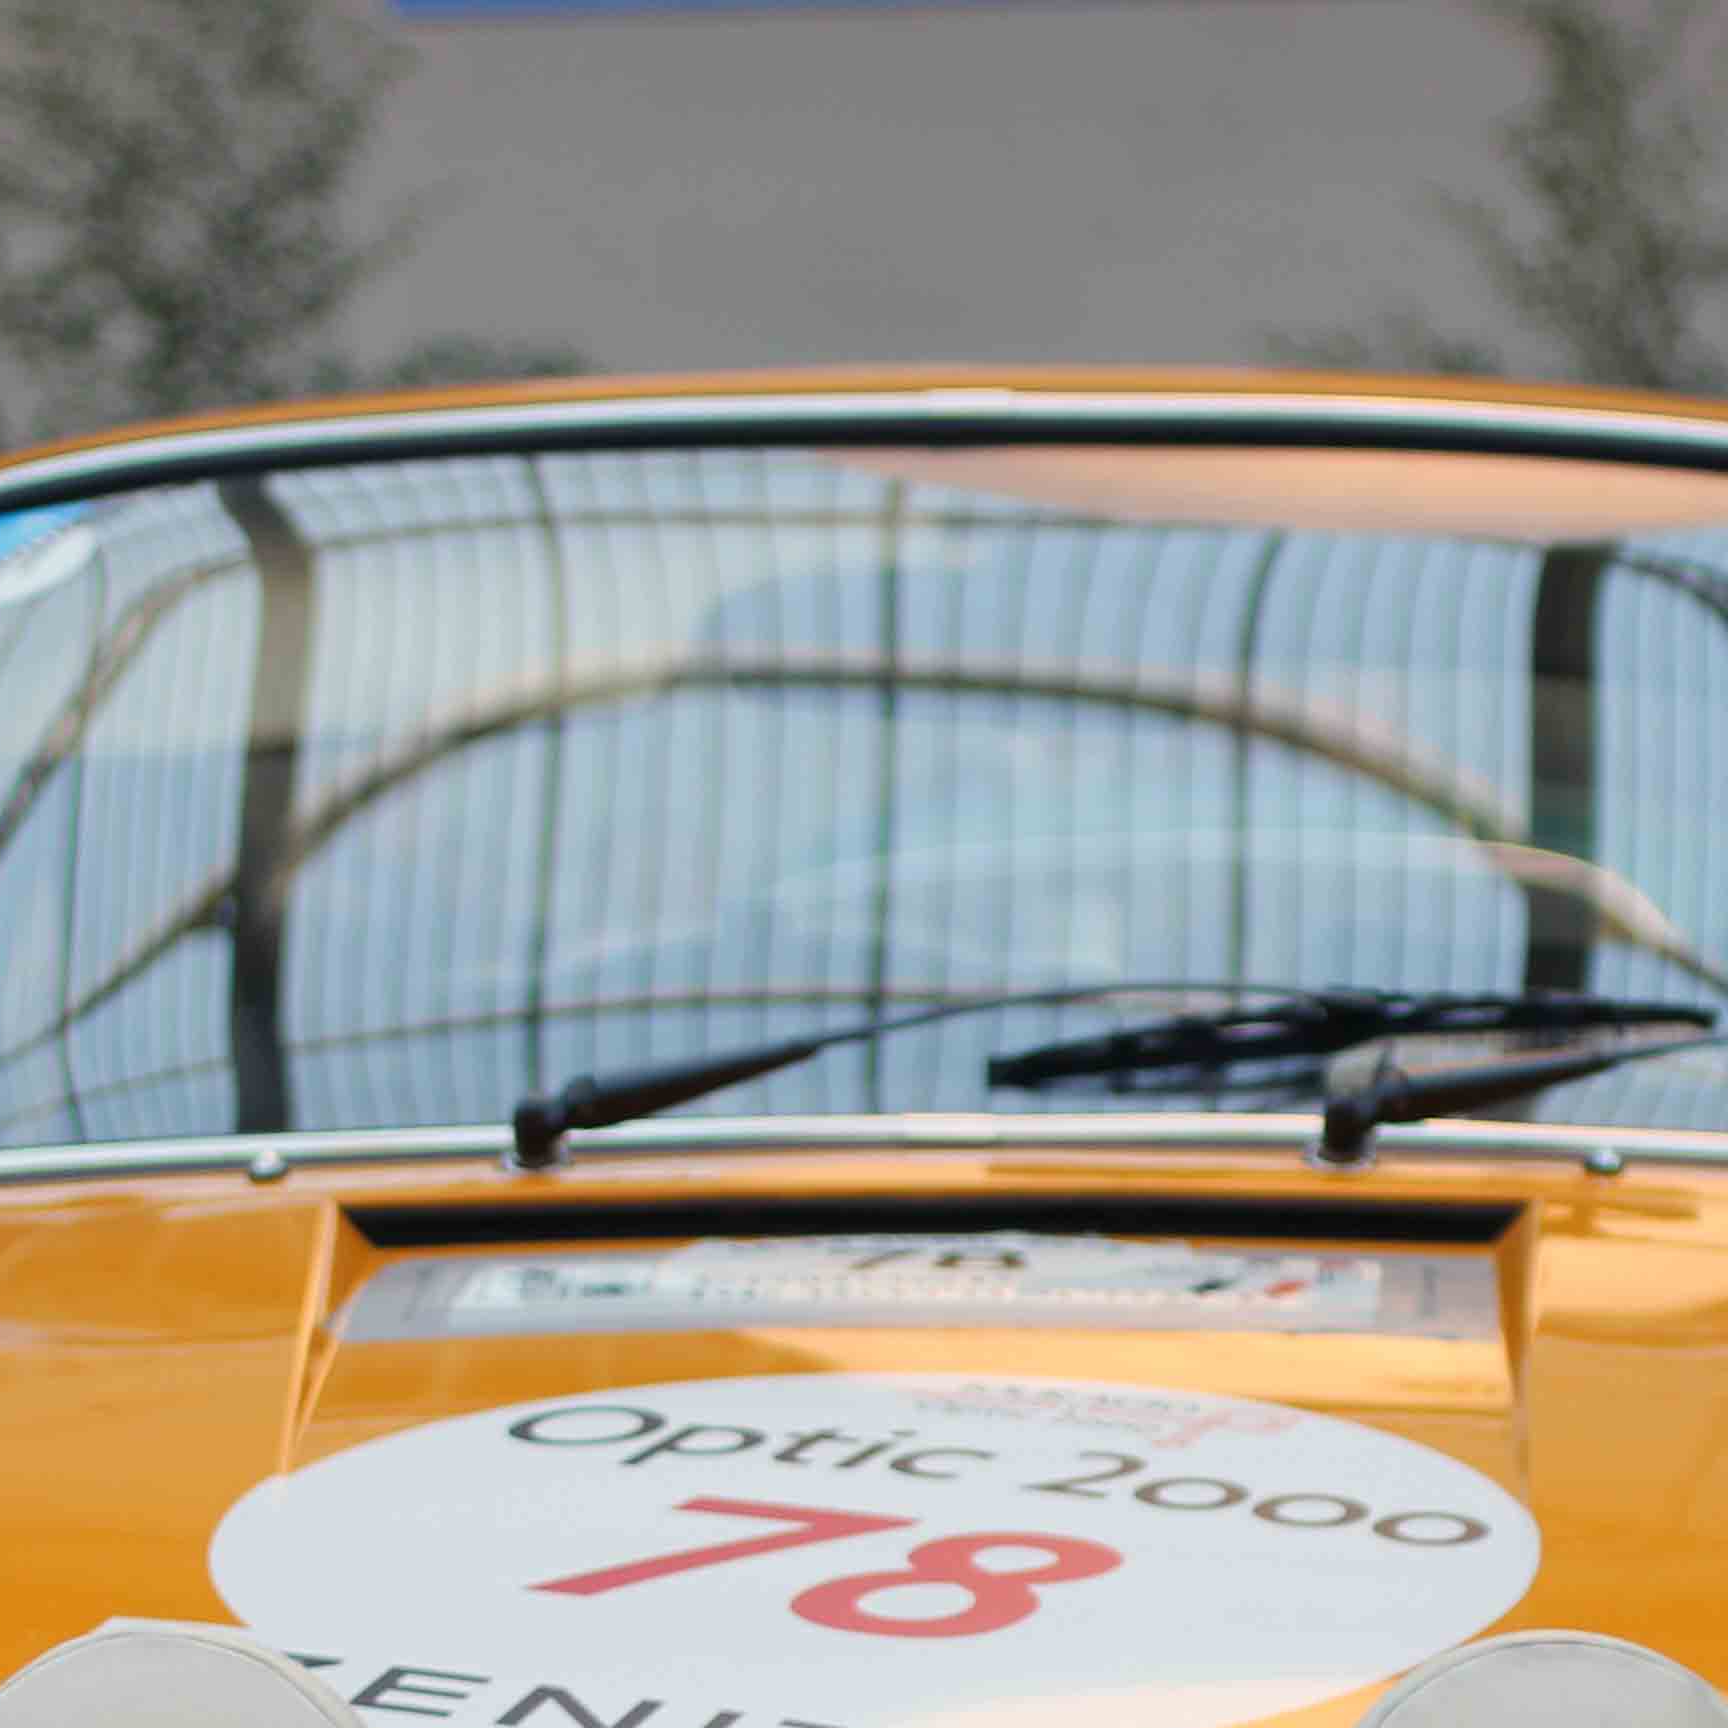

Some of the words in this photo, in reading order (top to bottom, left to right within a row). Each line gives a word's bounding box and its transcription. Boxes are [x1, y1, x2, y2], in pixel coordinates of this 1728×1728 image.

[508, 1403, 995, 1480] Optic
[1021, 1450, 1489, 1547] 2000
[522, 1496, 1125, 1639] 78
